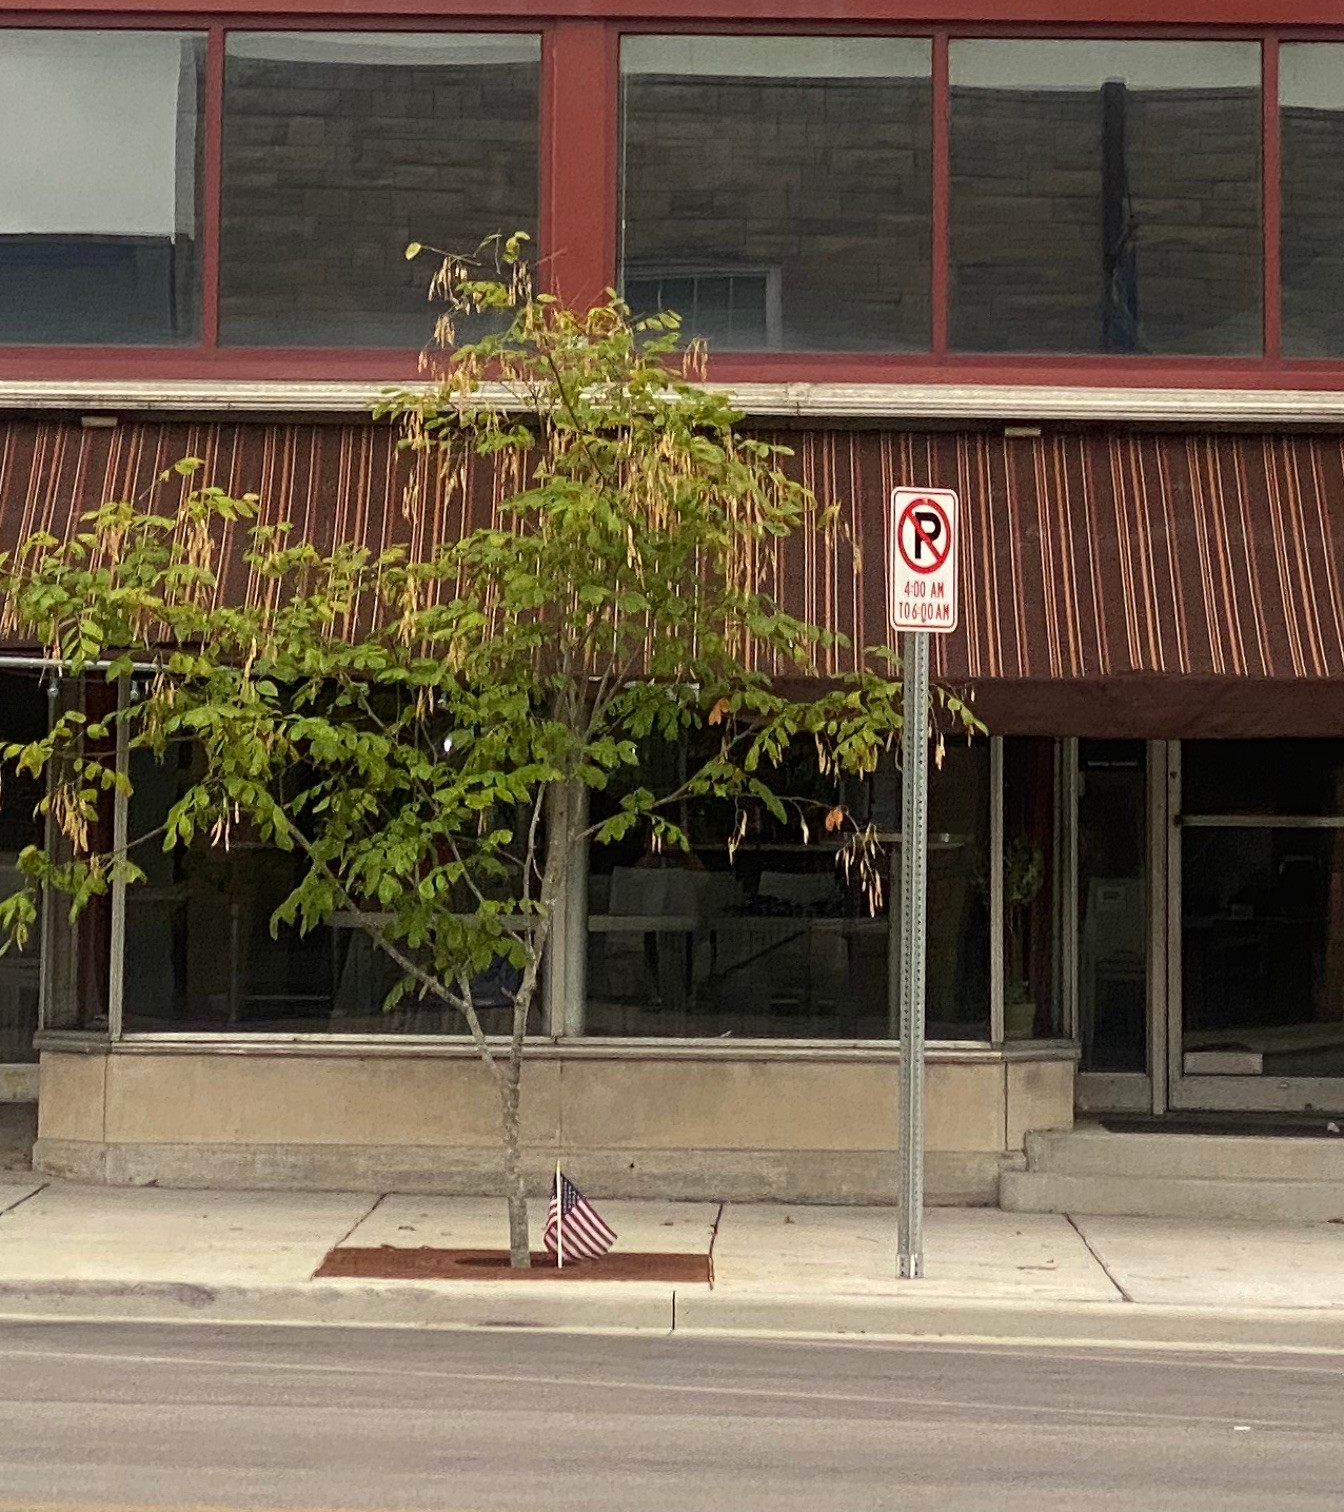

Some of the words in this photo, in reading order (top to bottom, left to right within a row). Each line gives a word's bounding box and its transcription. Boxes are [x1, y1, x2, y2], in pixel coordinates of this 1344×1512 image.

[904, 581, 926, 598] 4:00
[930, 582, 945, 598] AM
[935, 603, 950, 621] AM
